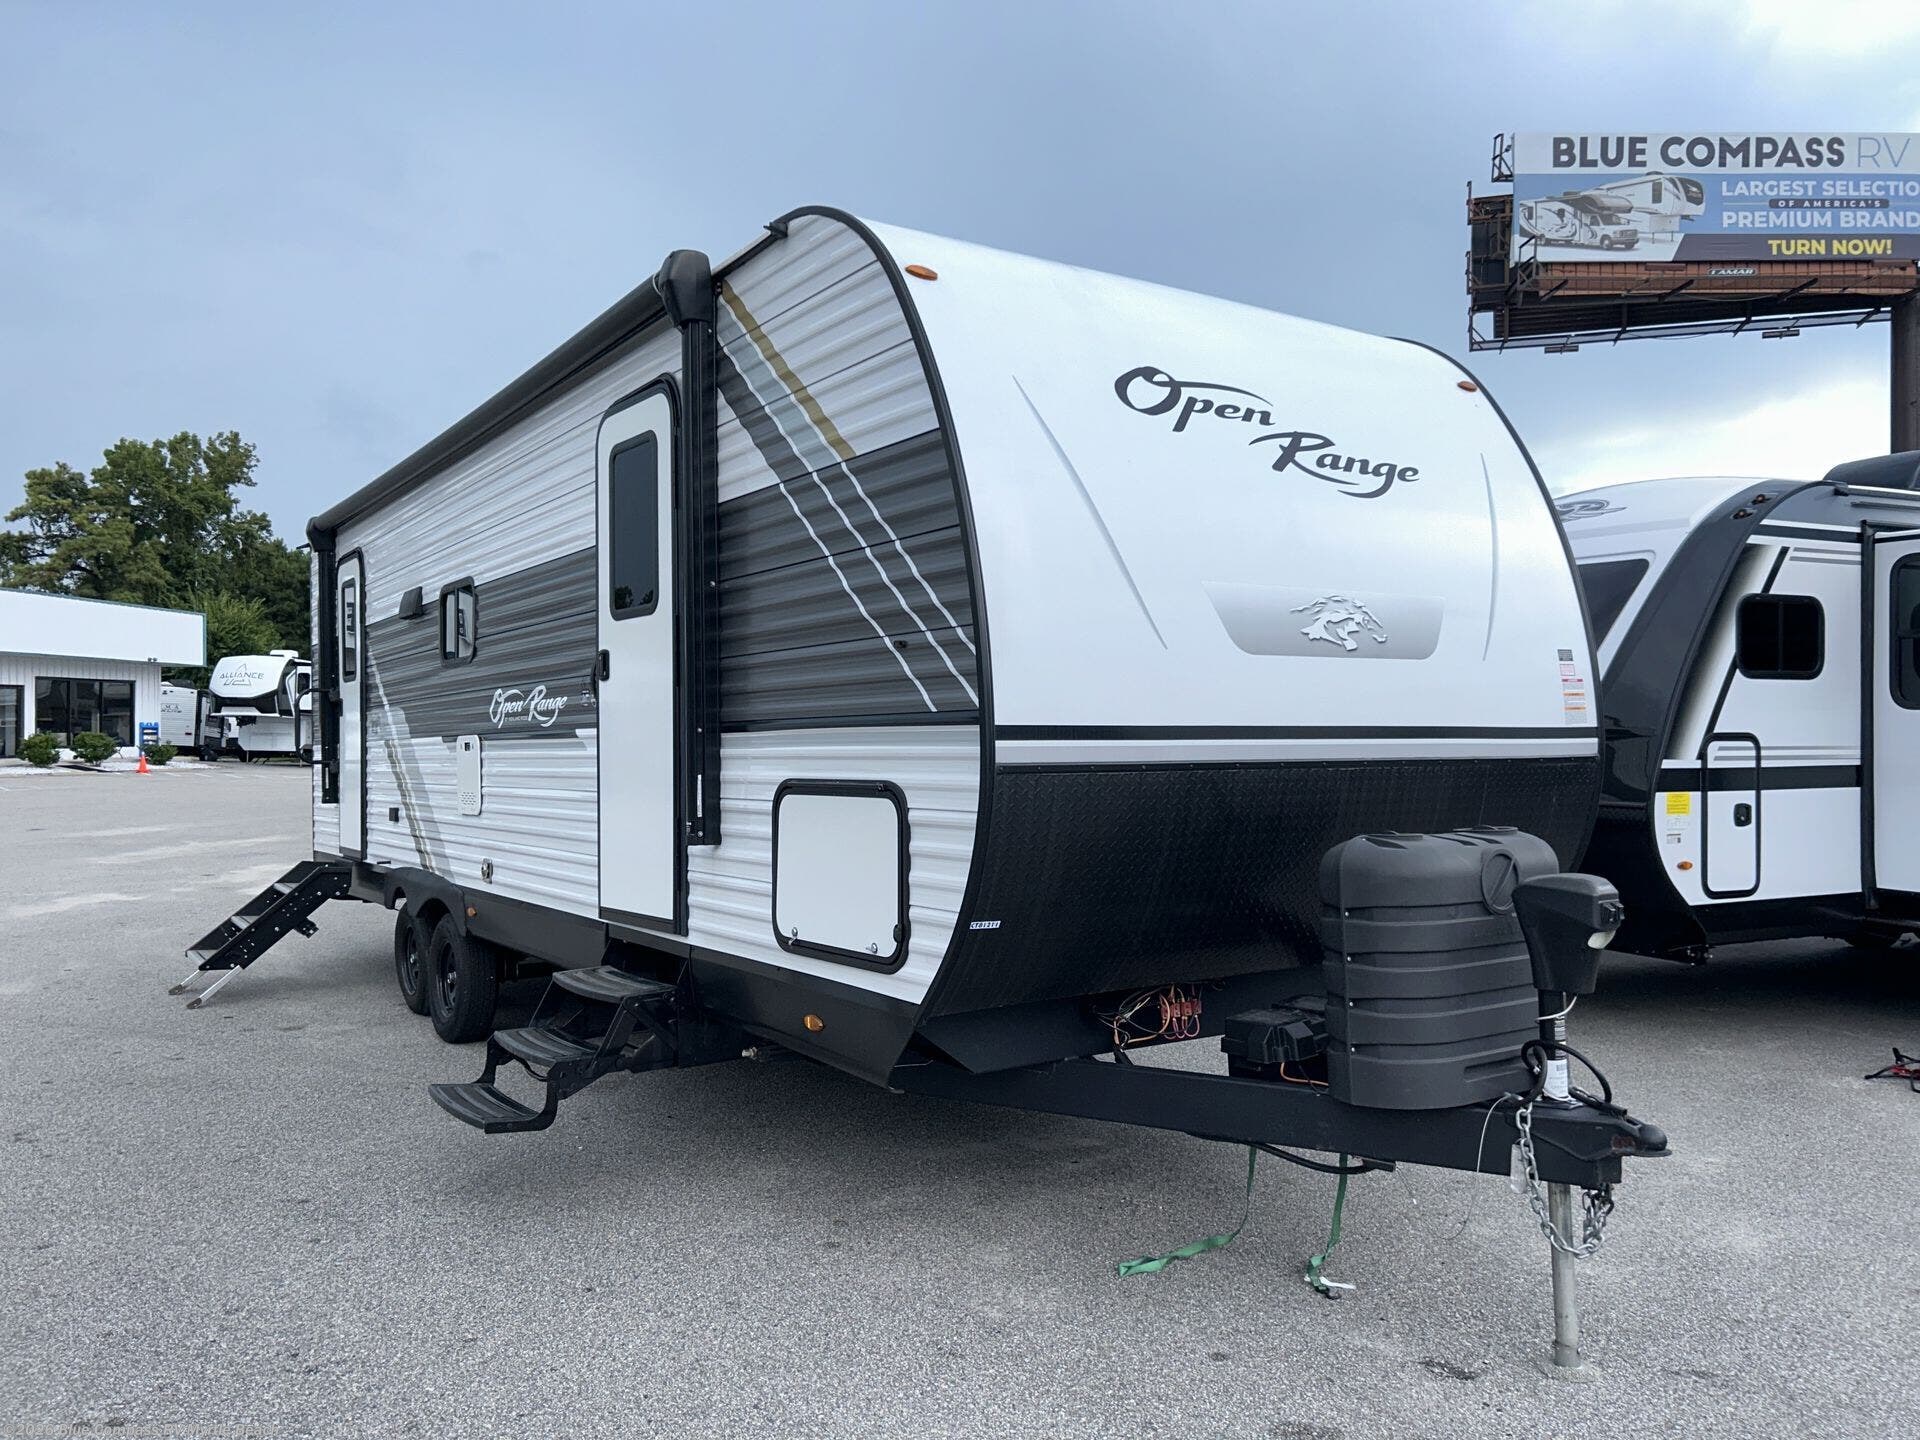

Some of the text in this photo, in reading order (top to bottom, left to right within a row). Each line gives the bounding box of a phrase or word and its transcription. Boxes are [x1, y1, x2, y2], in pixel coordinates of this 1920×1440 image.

[1552, 136, 1911, 168] BLUE COMPASS RV
[1721, 180, 1816, 197] LARGEST
[1778, 199, 1881, 208] OF AMERICA'S
[1722, 211, 1920, 228] PREMIUM BRAND
[1768, 239, 1893, 255] TURN NOW!
[1114, 366, 1276, 433] Open
[1248, 431, 1421, 499] Range
[219, 671, 265, 680] ALLIANCE
[489, 685, 568, 729] Open Range
